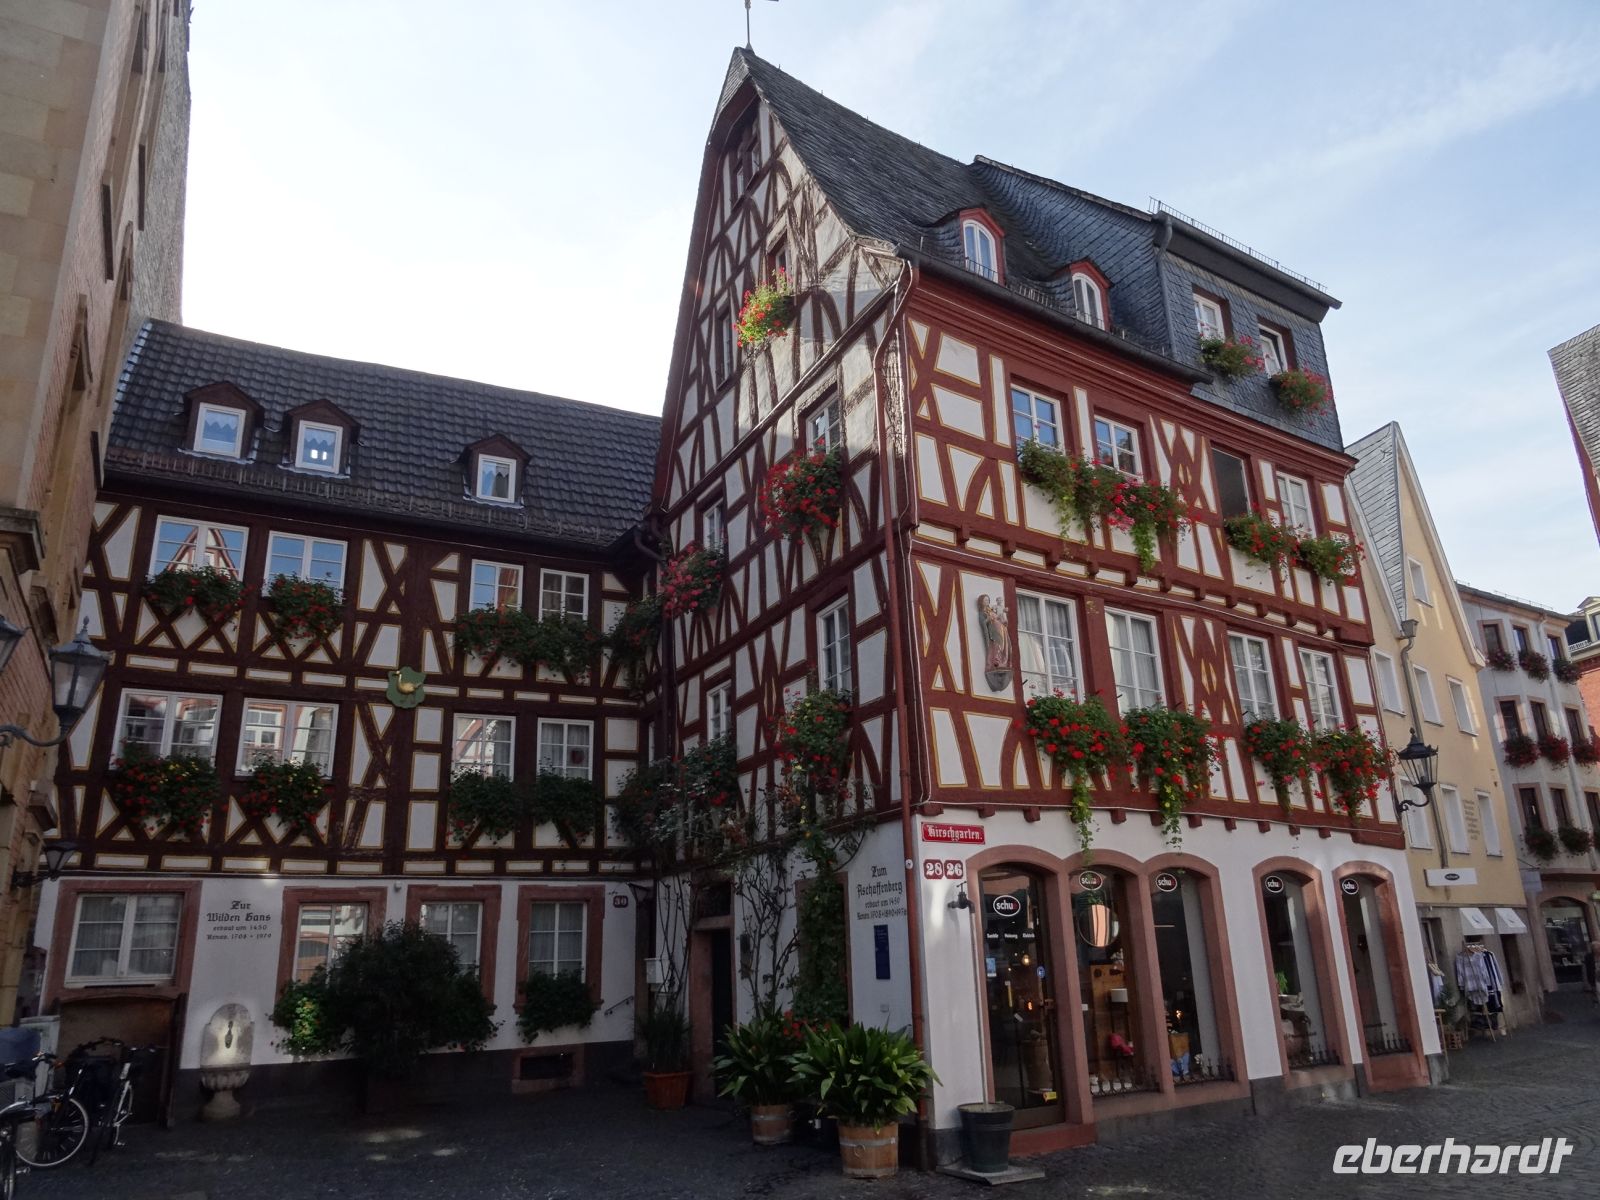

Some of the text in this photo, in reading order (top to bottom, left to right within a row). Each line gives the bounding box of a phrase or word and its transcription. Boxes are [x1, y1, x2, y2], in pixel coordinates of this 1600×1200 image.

[871, 865, 887, 878] Zum
[925, 862, 943, 876] 28
[946, 862, 963, 877] 26
[230, 900, 252, 910] Zur
[206, 912, 271, 922] Wilden Gans
